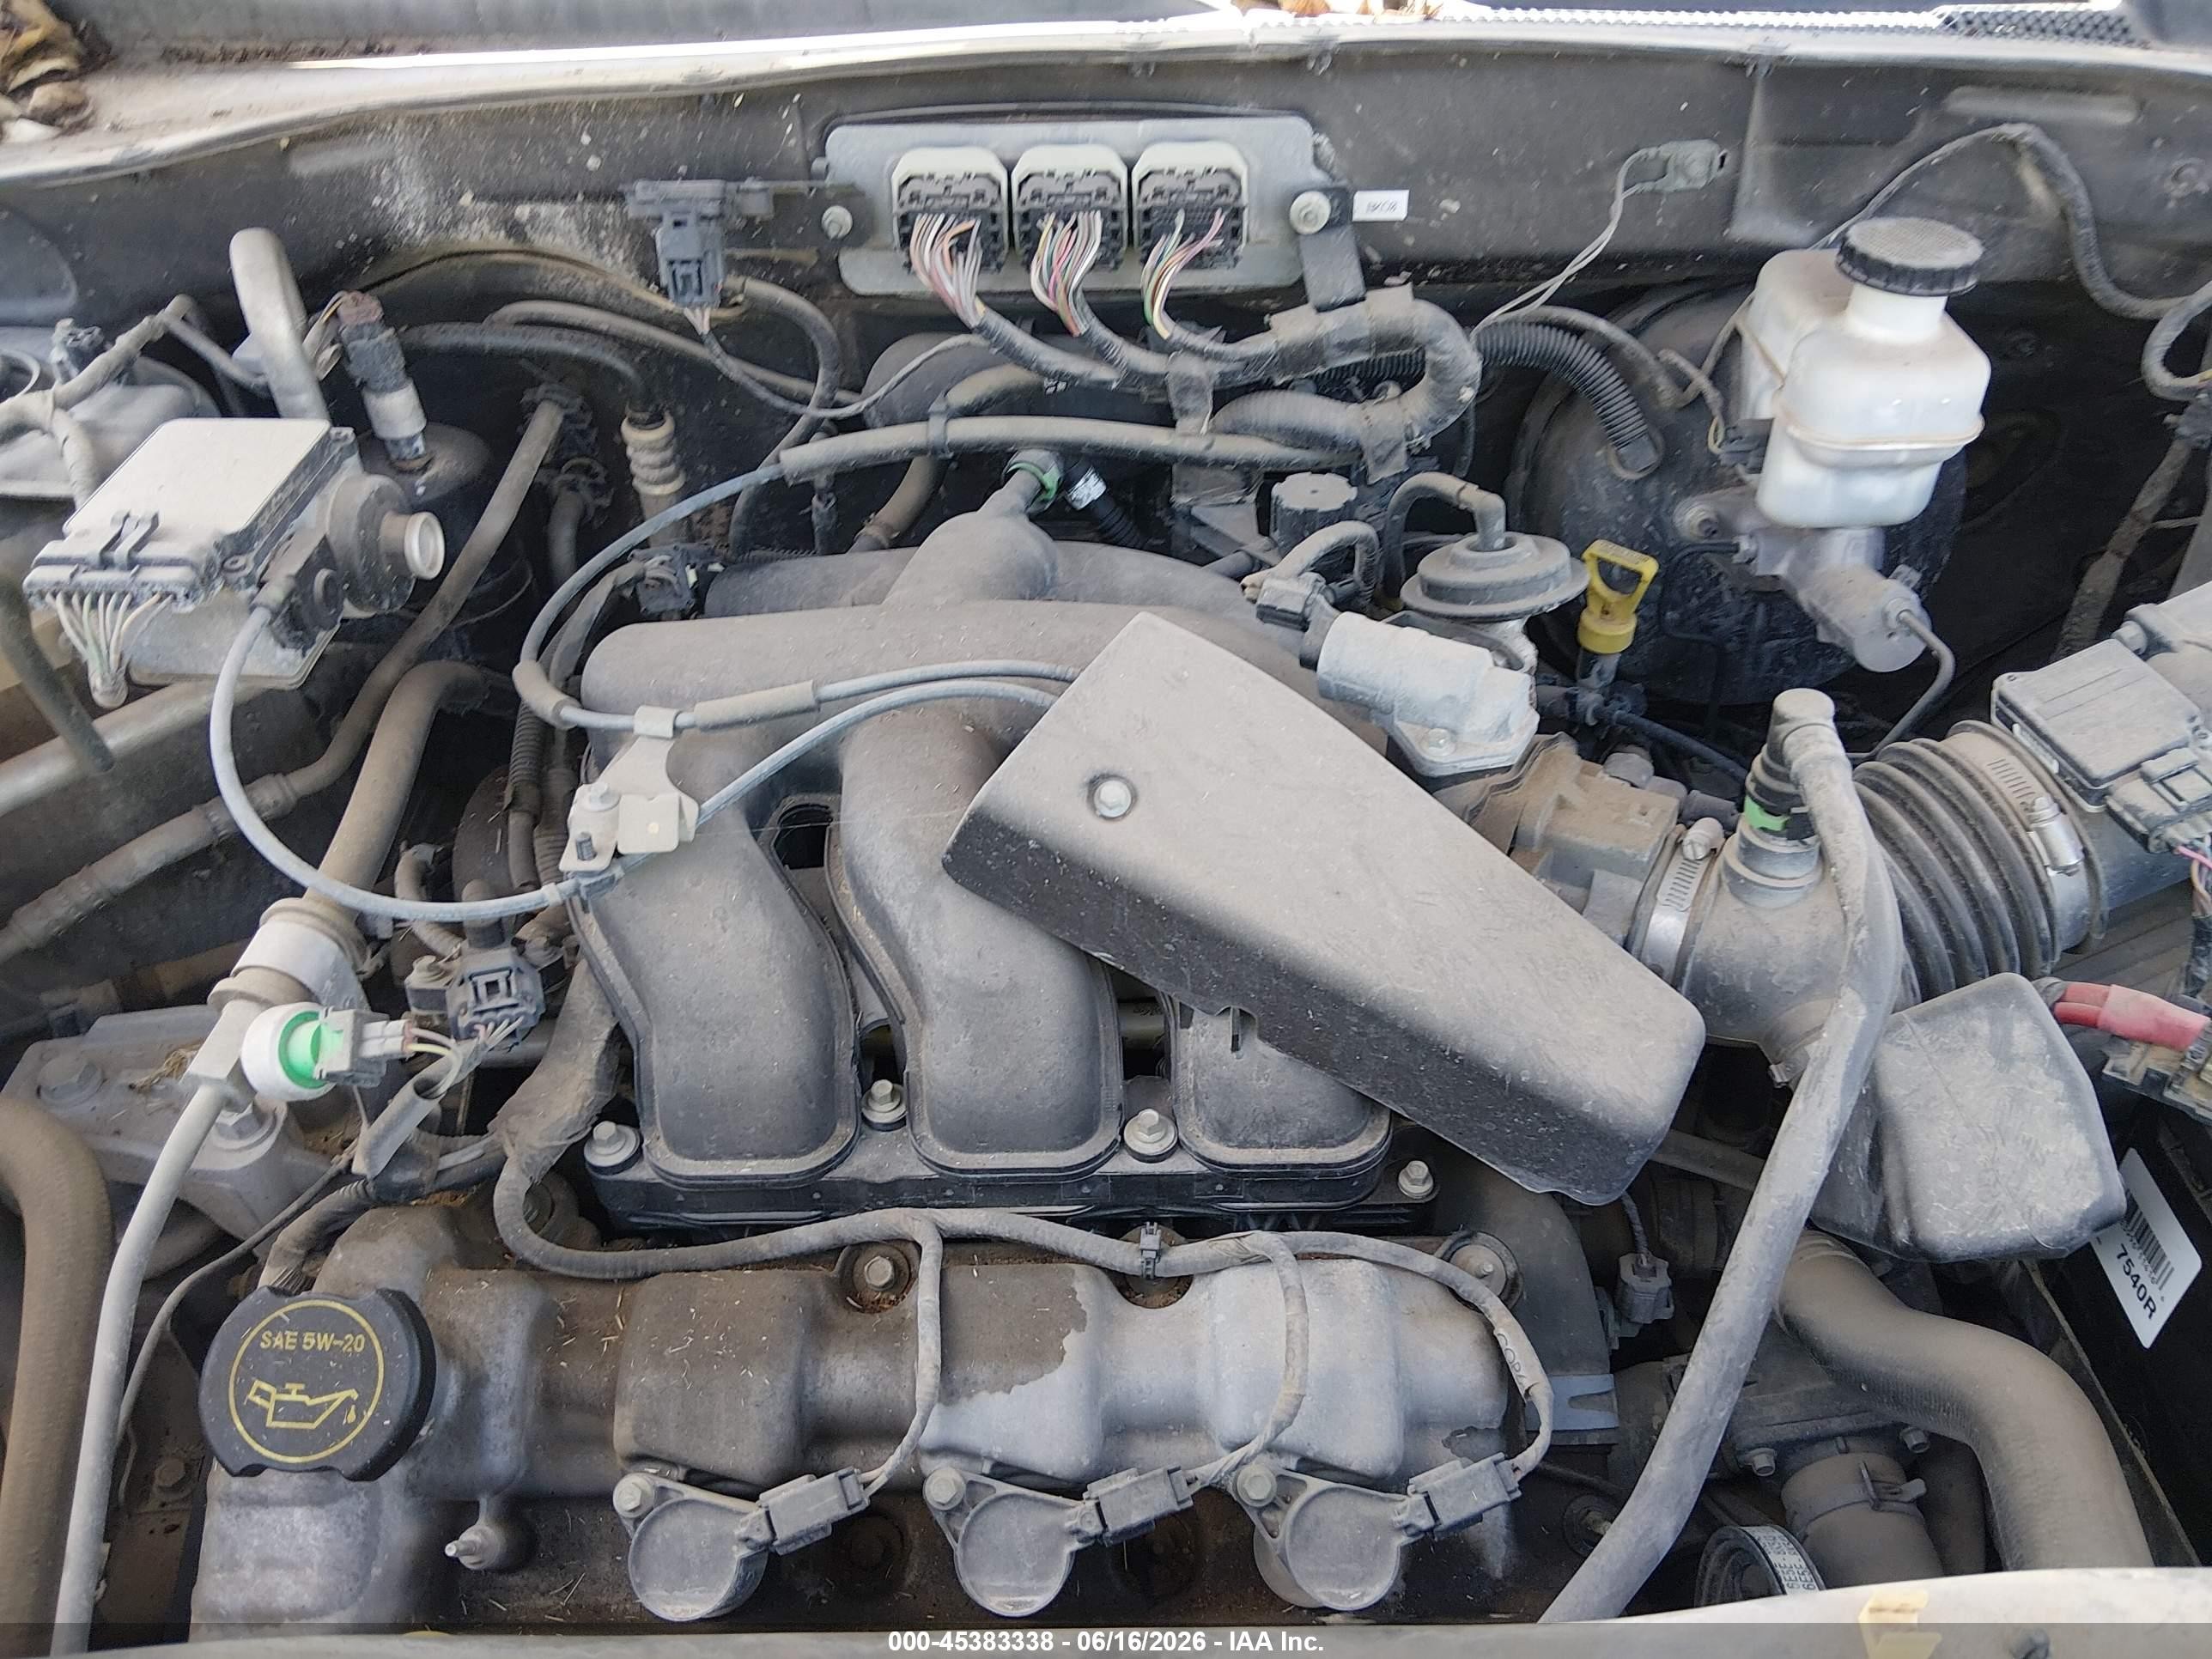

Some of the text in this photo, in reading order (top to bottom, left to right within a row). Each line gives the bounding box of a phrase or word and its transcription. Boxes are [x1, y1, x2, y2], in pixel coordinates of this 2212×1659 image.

[2116, 1243, 2157, 1320] 7540R
[259, 1330, 366, 1352] SAE 5W-20
